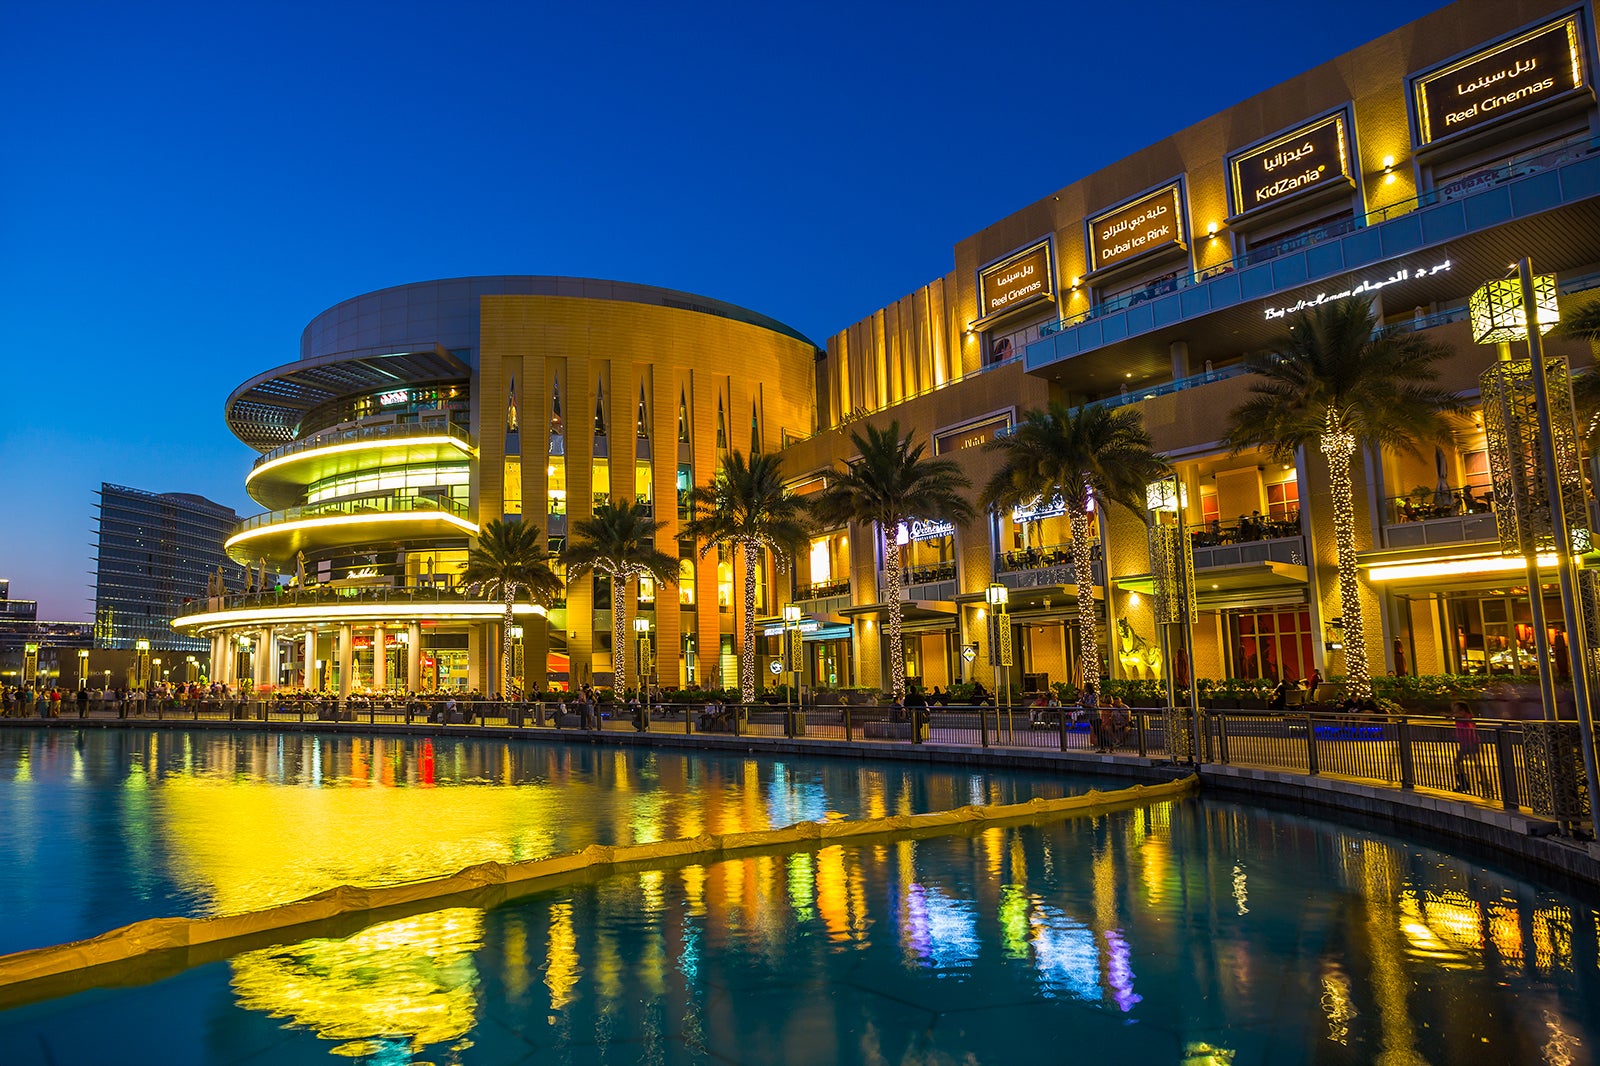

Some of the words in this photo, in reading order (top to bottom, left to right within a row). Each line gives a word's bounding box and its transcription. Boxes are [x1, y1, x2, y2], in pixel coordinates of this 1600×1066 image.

[1508, 58, 1537, 78] ريل
[1457, 70, 1506, 95] سينما
[1445, 103, 1479, 126] Reel
[1481, 77, 1554, 112] Cinemas
[1263, 141, 1314, 171] كيدزانيا
[1256, 169, 1320, 201] KidZania
[1128, 215, 1146, 231] دبي
[1146, 205, 1168, 219] حلبة
[1102, 219, 1128, 240] للتزلج
[1281, 229, 1329, 251] OUTBCK
[1102, 239, 1131, 259] Dubai
[1132, 235, 1146, 248] Ice
[1147, 224, 1169, 241] Rink
[997, 271, 1020, 287] سينما
[1020, 265, 1034, 278] ريل
[991, 293, 1008, 308] Reel
[1008, 280, 1042, 301] Cinemas
